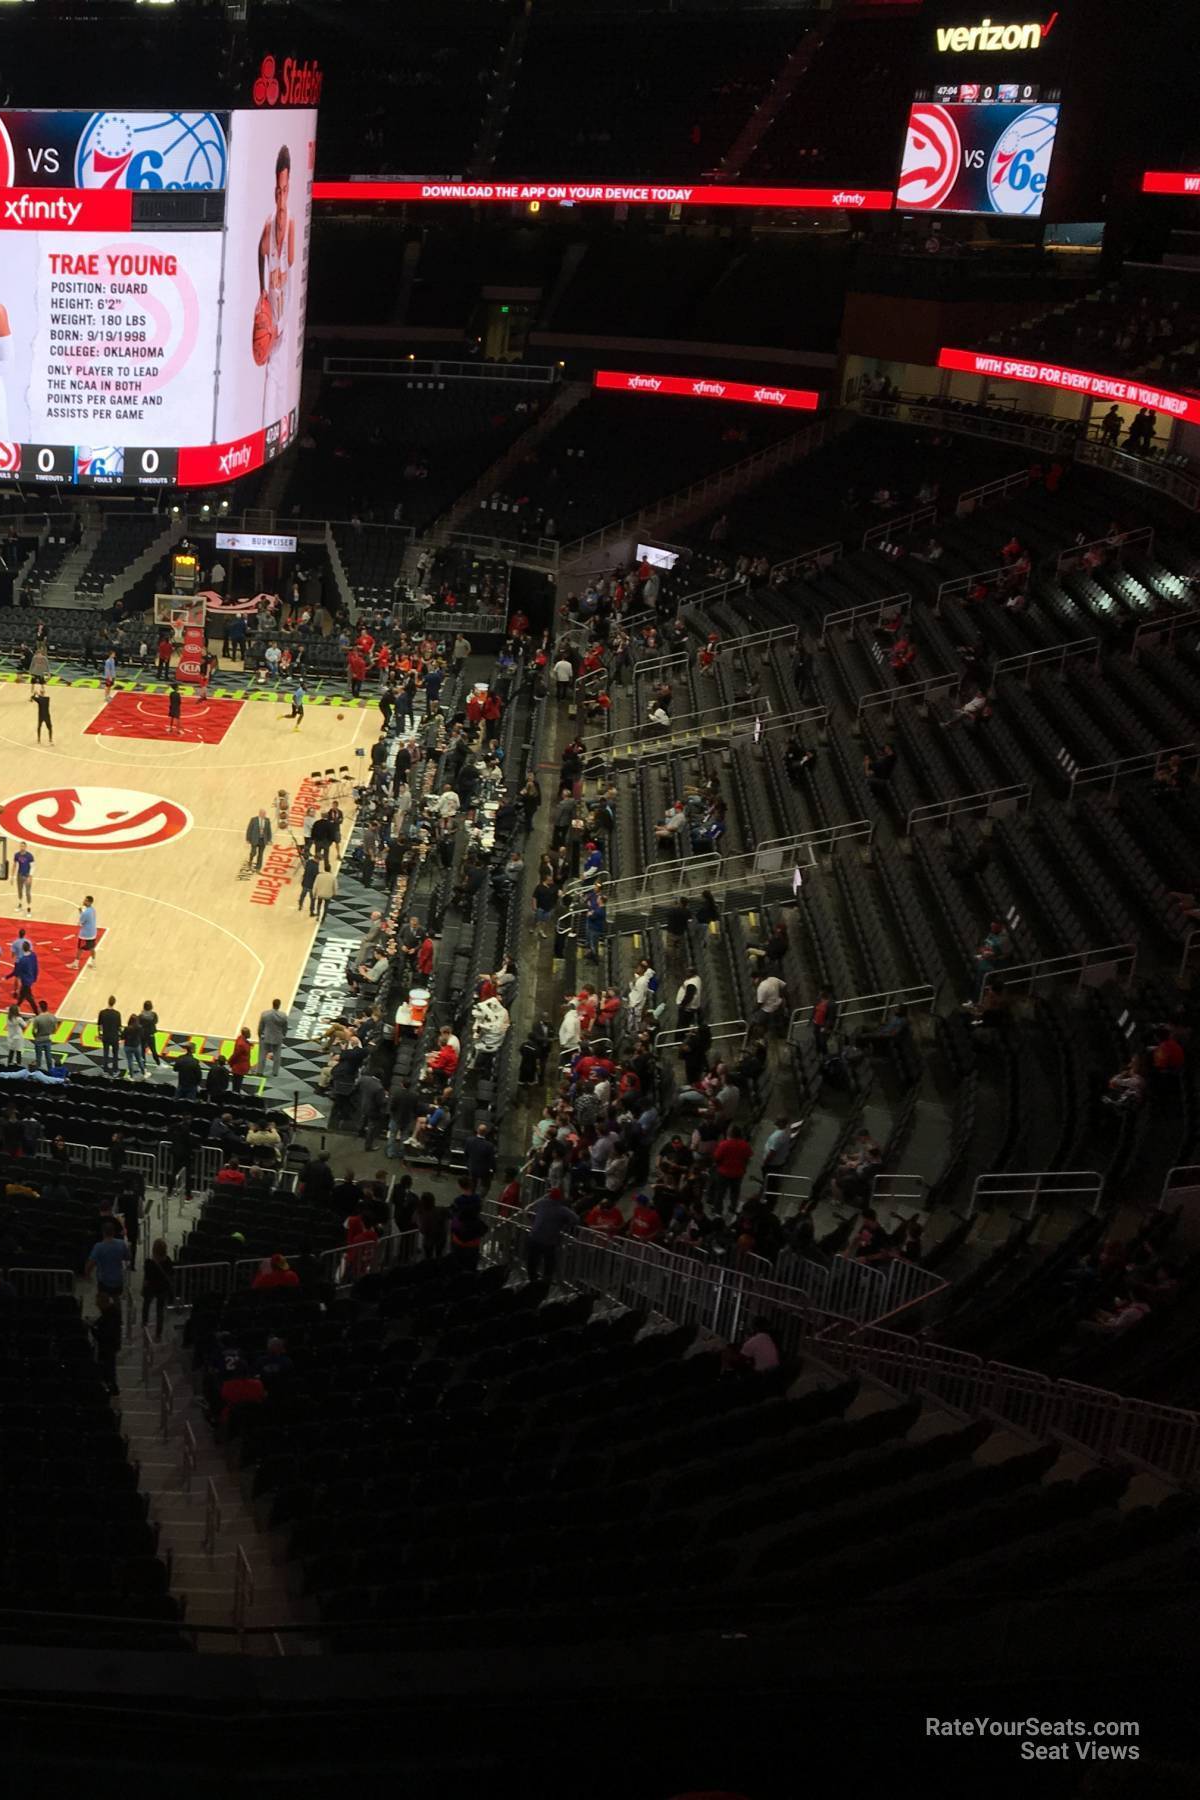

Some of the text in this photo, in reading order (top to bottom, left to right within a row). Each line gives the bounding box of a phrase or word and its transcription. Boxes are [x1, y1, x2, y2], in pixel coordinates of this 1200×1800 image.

[936, 18, 1041, 52] verizon
[984, 86, 992, 98] 0
[1023, 85, 1032, 97] 0
[27, 147, 60, 173] VS
[965, 150, 985, 168] VS
[421, 185, 692, 200] DOWNLOAD THE APP ON YOUR DEVICE TODAY
[832, 192, 866, 206] xfinity
[4, 194, 82, 225] xfinity
[48, 253, 178, 277] TRAE YOUNG
[51, 282, 149, 295] POSITION: GUARD
[51, 298, 94, 310] HEIGHT:
[50, 313, 147, 327] WEIGHT: 180 LBS
[50, 329, 147, 342] BORN: 9/19/1998
[50, 345, 165, 358] COLLEGE: OKLAHOMA
[47, 364, 159, 377] ONLY PLAYER TO LEAD
[47, 379, 142, 391] THE NCAA IN BOTH
[628, 375, 662, 391] xfinity
[692, 380, 726, 397] xfinity
[975, 356, 1189, 415] WITH SPEED FOR EVERY DEVICE IN YOUR LINEUP
[47, 393, 163, 406] POINTS PER GAME AND
[754, 387, 787, 405] xfinity
[47, 407, 144, 420] ASSISTS PER GAME
[37, 448, 55, 473] 0
[141, 449, 159, 473] 0
[219, 444, 252, 475] xfinity
[35, 474, 64, 482] TIMEOUTS
[251, 537, 294, 547] BUDWEISER
[183, 663, 201, 673] KIA
[295, 989, 325, 1040] Casino Resort
